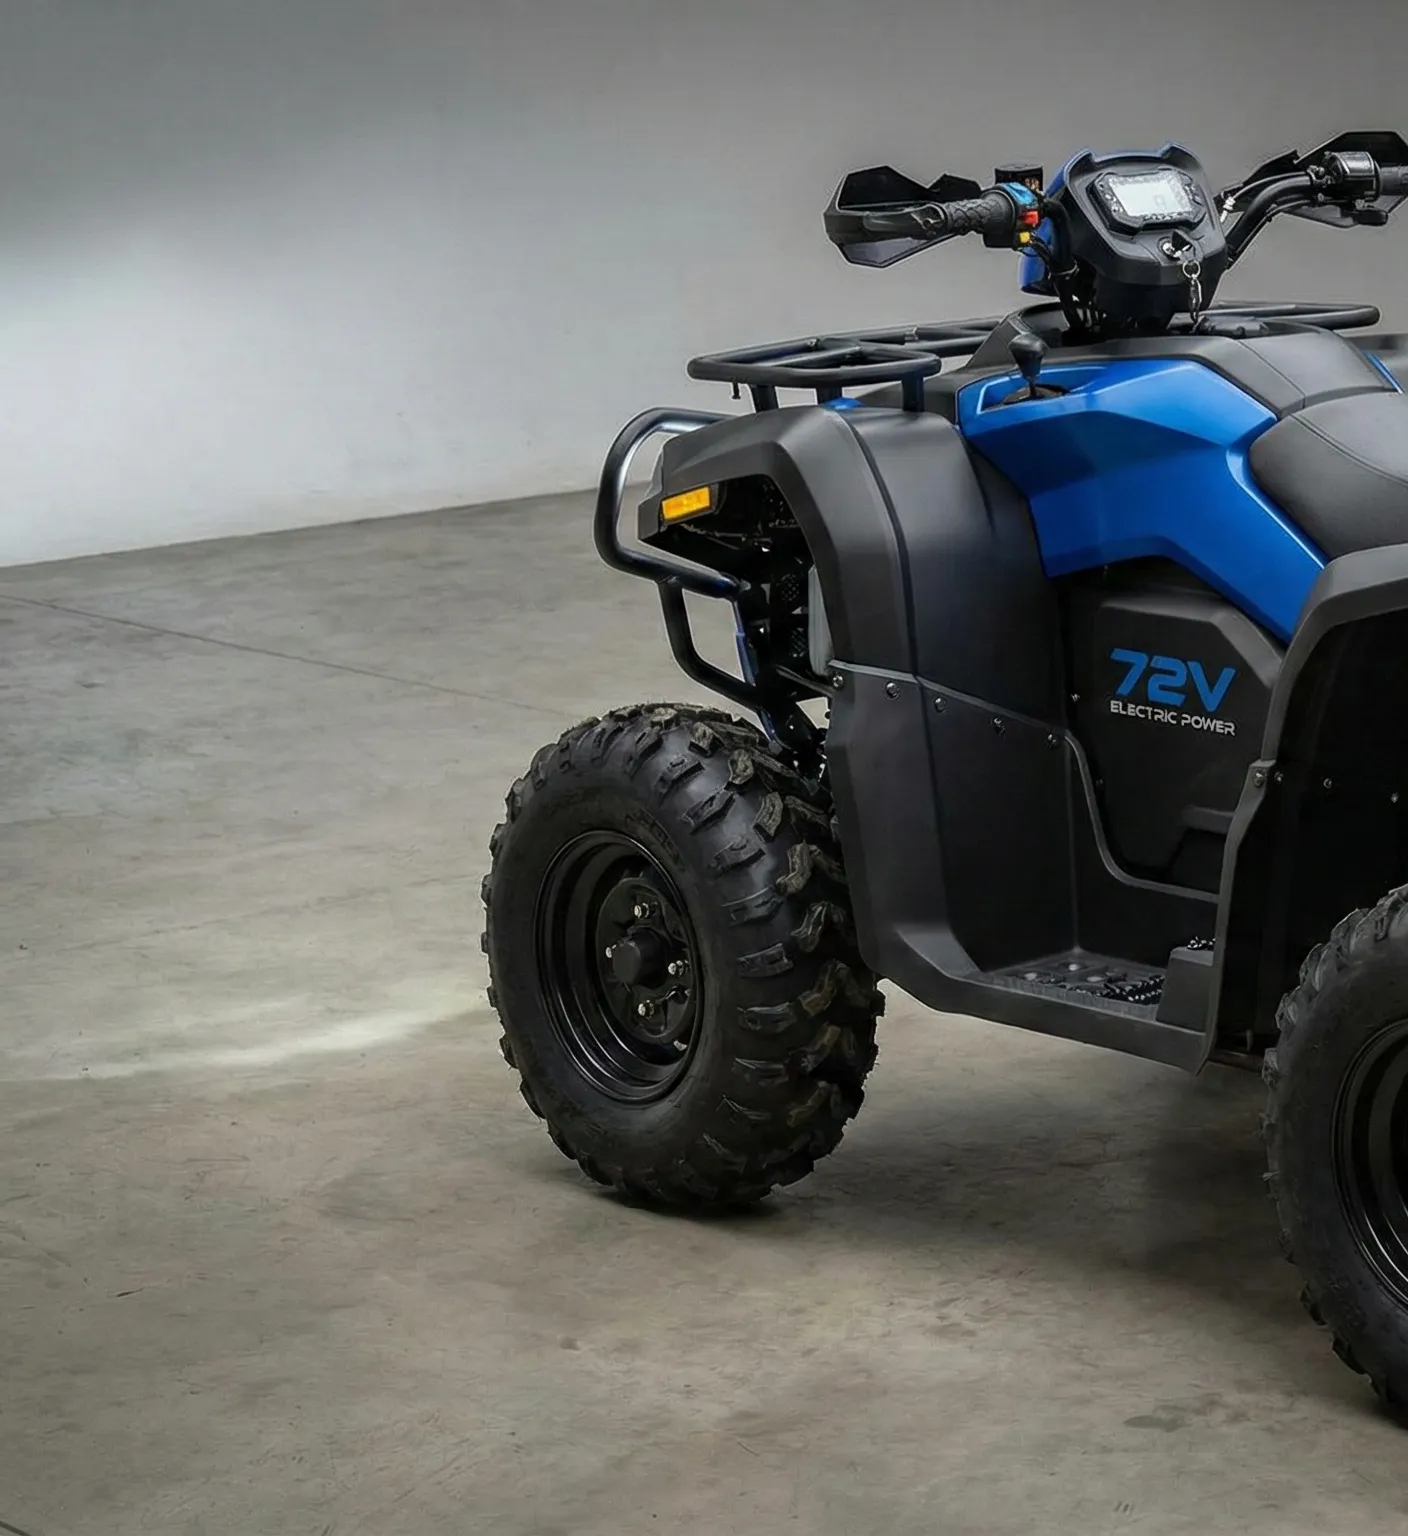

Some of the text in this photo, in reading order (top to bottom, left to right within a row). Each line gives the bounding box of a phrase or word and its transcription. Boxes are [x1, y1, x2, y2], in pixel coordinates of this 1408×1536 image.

[1110, 648, 1236, 713] 72V
[1110, 700, 1236, 736] ELECTRIC POWER
